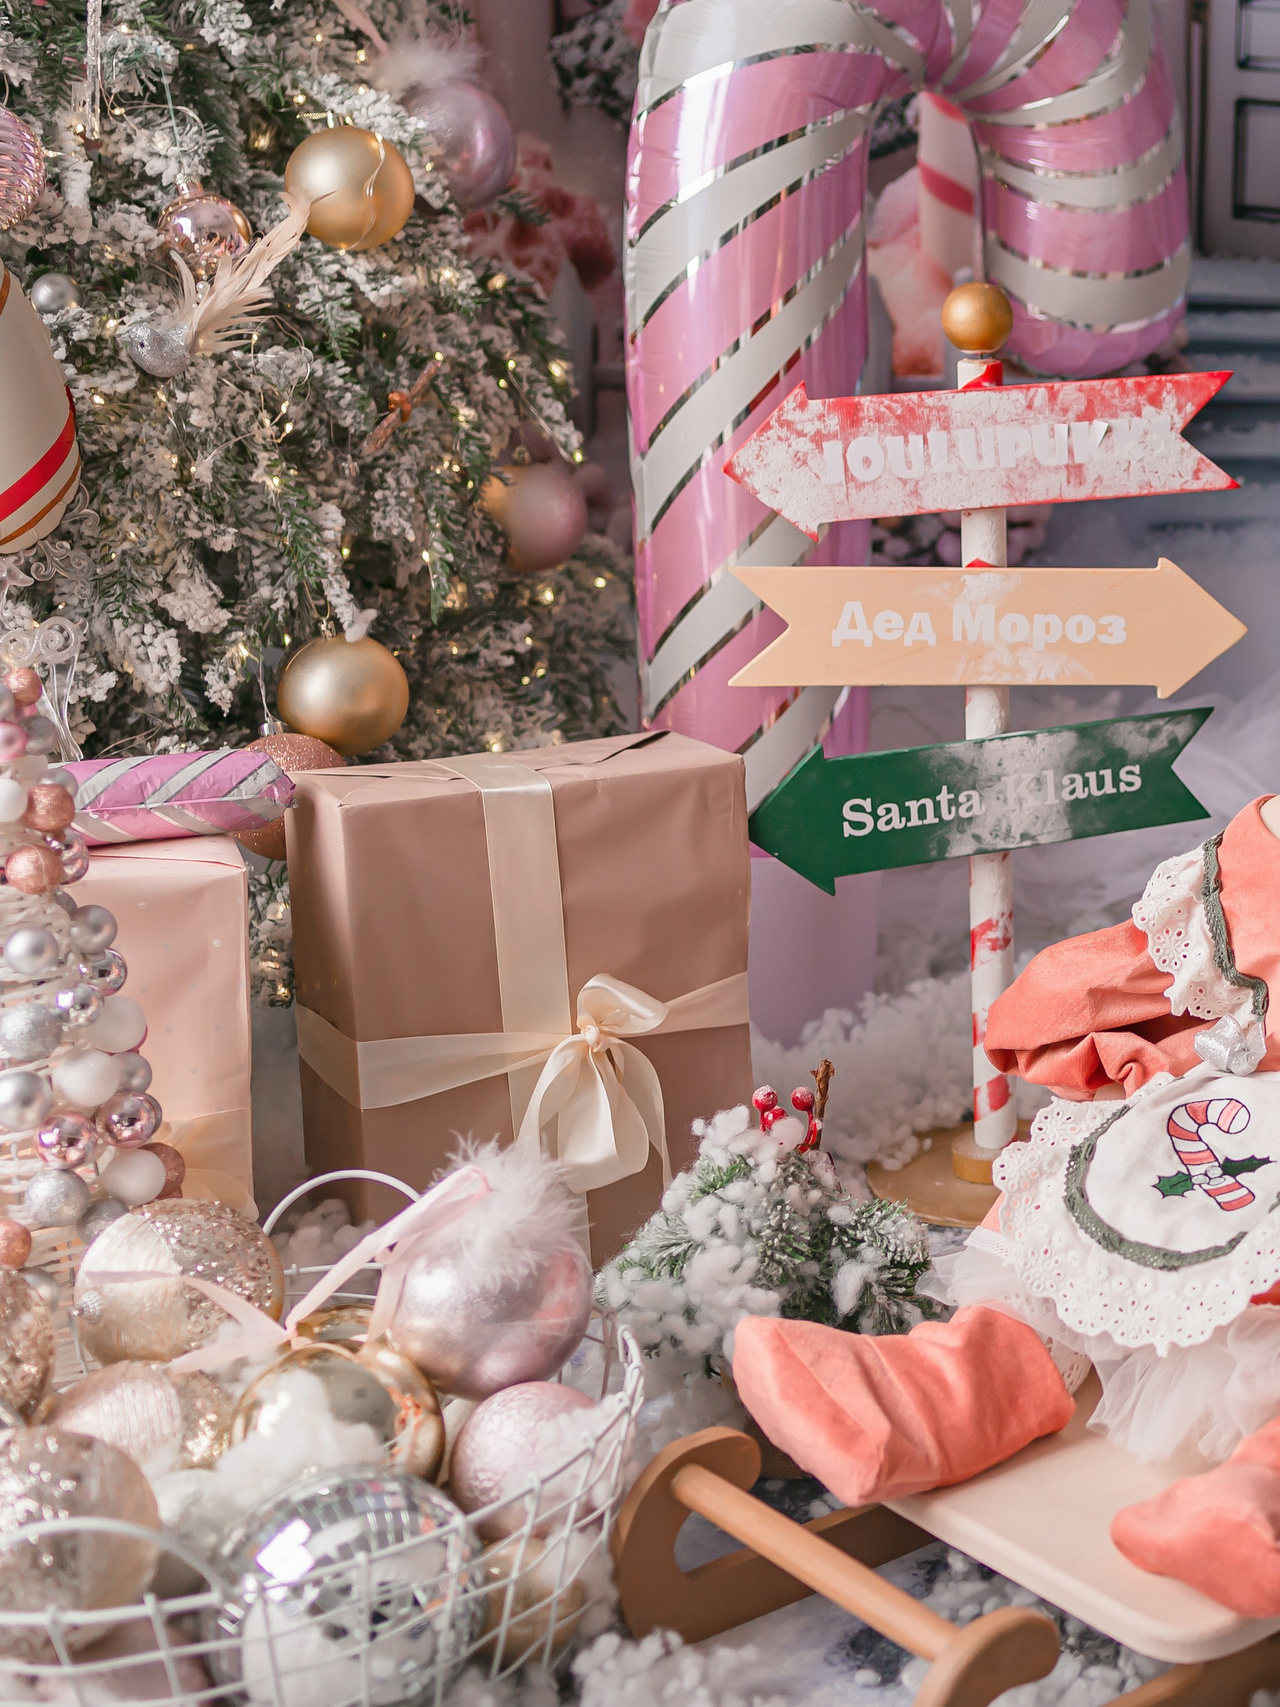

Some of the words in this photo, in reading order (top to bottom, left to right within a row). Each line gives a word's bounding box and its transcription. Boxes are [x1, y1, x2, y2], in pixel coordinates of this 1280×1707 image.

[831, 601, 937, 647] Дед
[952, 603, 1127, 651] Мороз
[841, 784, 985, 838] Santa
[1001, 764, 1143, 807] Klaus
